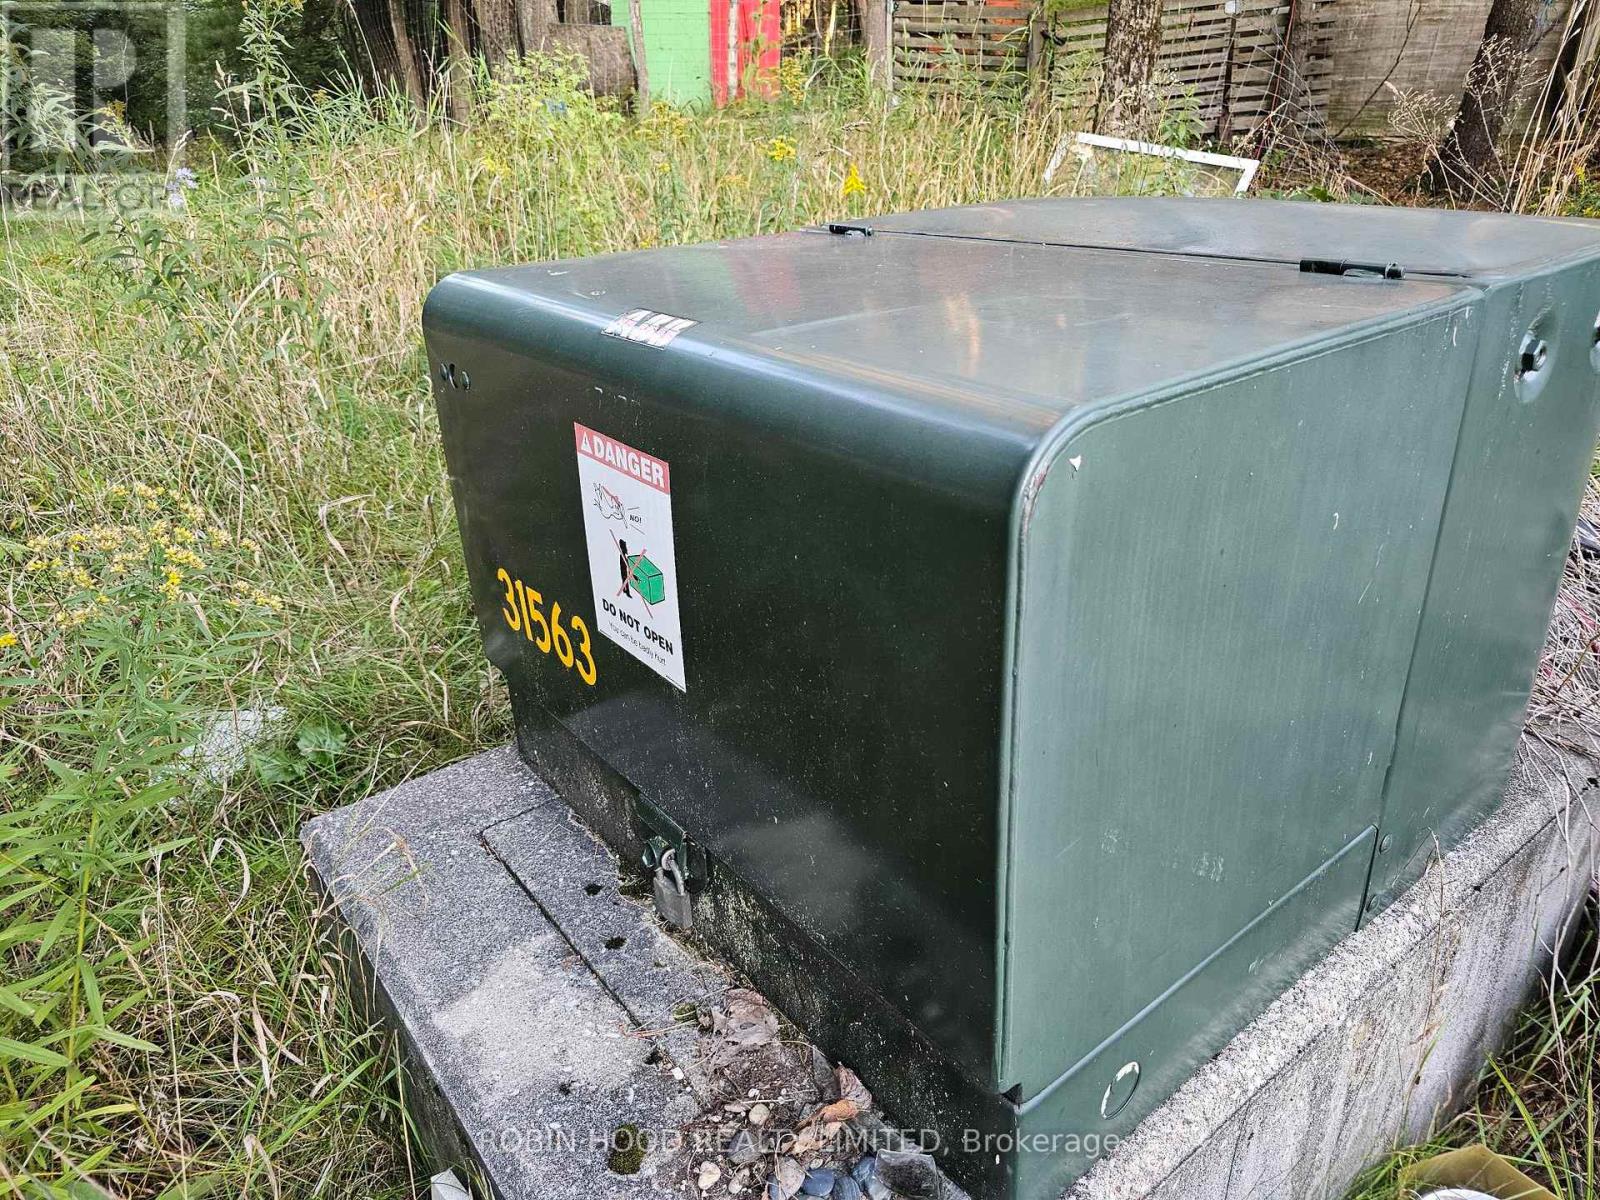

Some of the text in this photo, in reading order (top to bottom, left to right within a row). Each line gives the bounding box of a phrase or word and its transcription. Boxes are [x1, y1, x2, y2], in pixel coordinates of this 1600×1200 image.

[592, 436, 665, 488] DANGER
[629, 514, 642, 524] NO!
[497, 567, 597, 686] 31563
[602, 598, 674, 655] DO NOT OPEN
